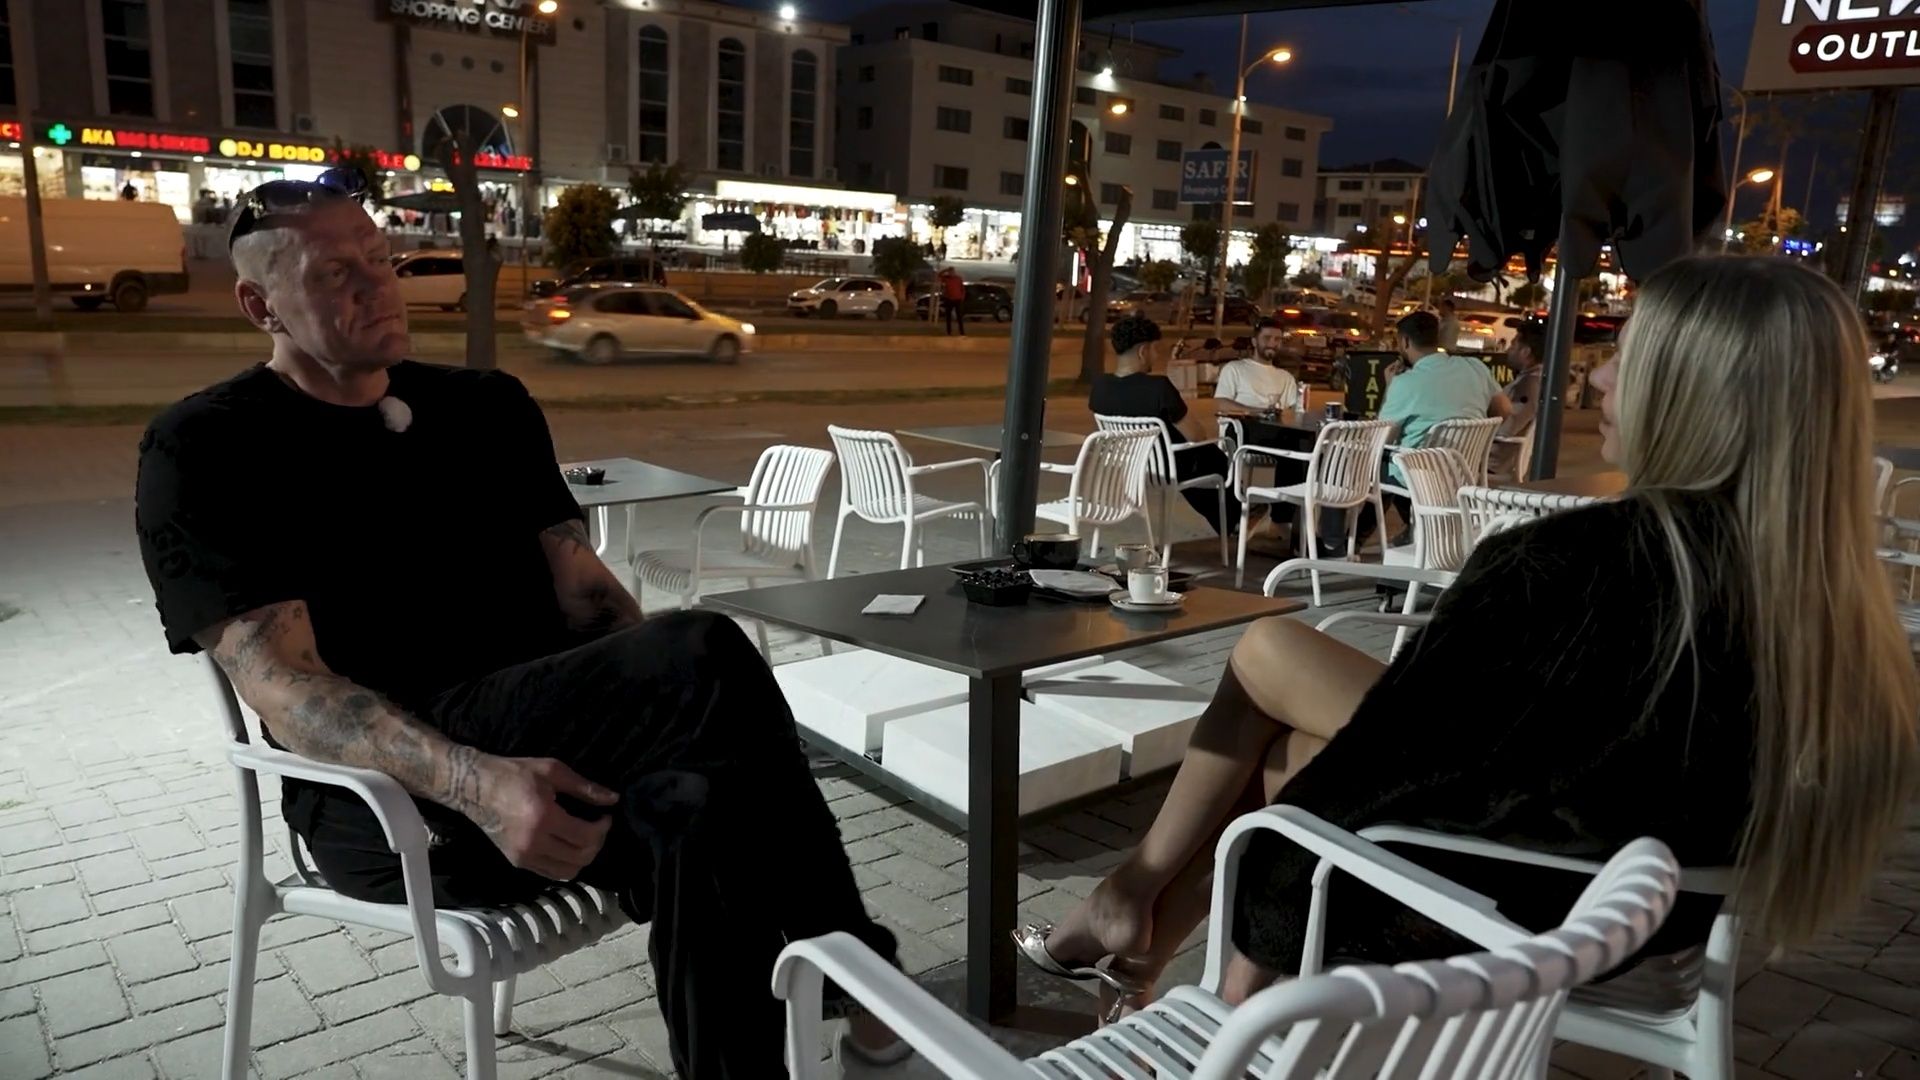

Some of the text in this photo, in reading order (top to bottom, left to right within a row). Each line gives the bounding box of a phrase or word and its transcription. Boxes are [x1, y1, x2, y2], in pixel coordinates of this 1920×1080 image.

[390, 0, 480, 25] SHOPPING
[81, 128, 115, 146] AKA
[236, 141, 265, 158] DJ
[268, 144, 325, 162] BOBO
